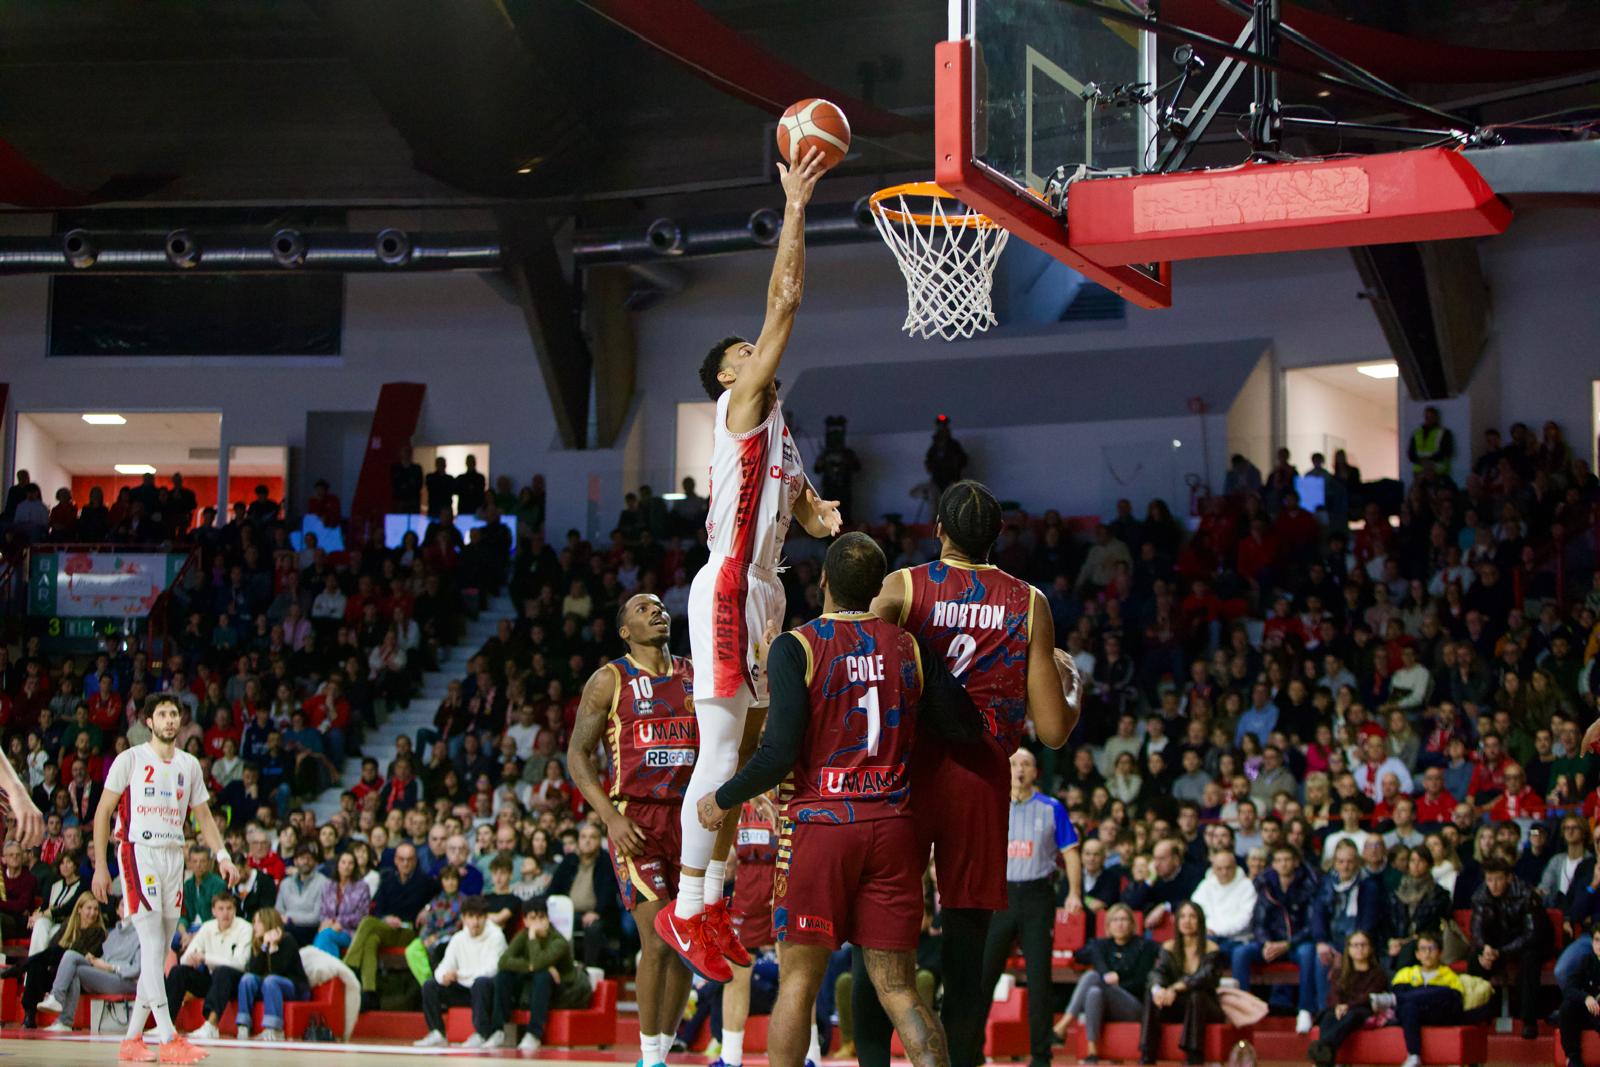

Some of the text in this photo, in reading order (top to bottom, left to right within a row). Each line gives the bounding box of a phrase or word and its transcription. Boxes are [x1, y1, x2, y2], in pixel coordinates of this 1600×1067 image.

[38, 559, 49, 601] BAR
[48, 617, 60, 636] 3
[716, 591, 734, 662] VARESE
[933, 600, 1005, 630] HORTON
[845, 655, 885, 682] COLE
[947, 634, 976, 678] 2
[628, 676, 654, 700] 10
[858, 686, 880, 757] 1
[647, 751, 694, 765] RBcare
[144, 765, 155, 783] 2
[175, 890, 183, 908] 2
